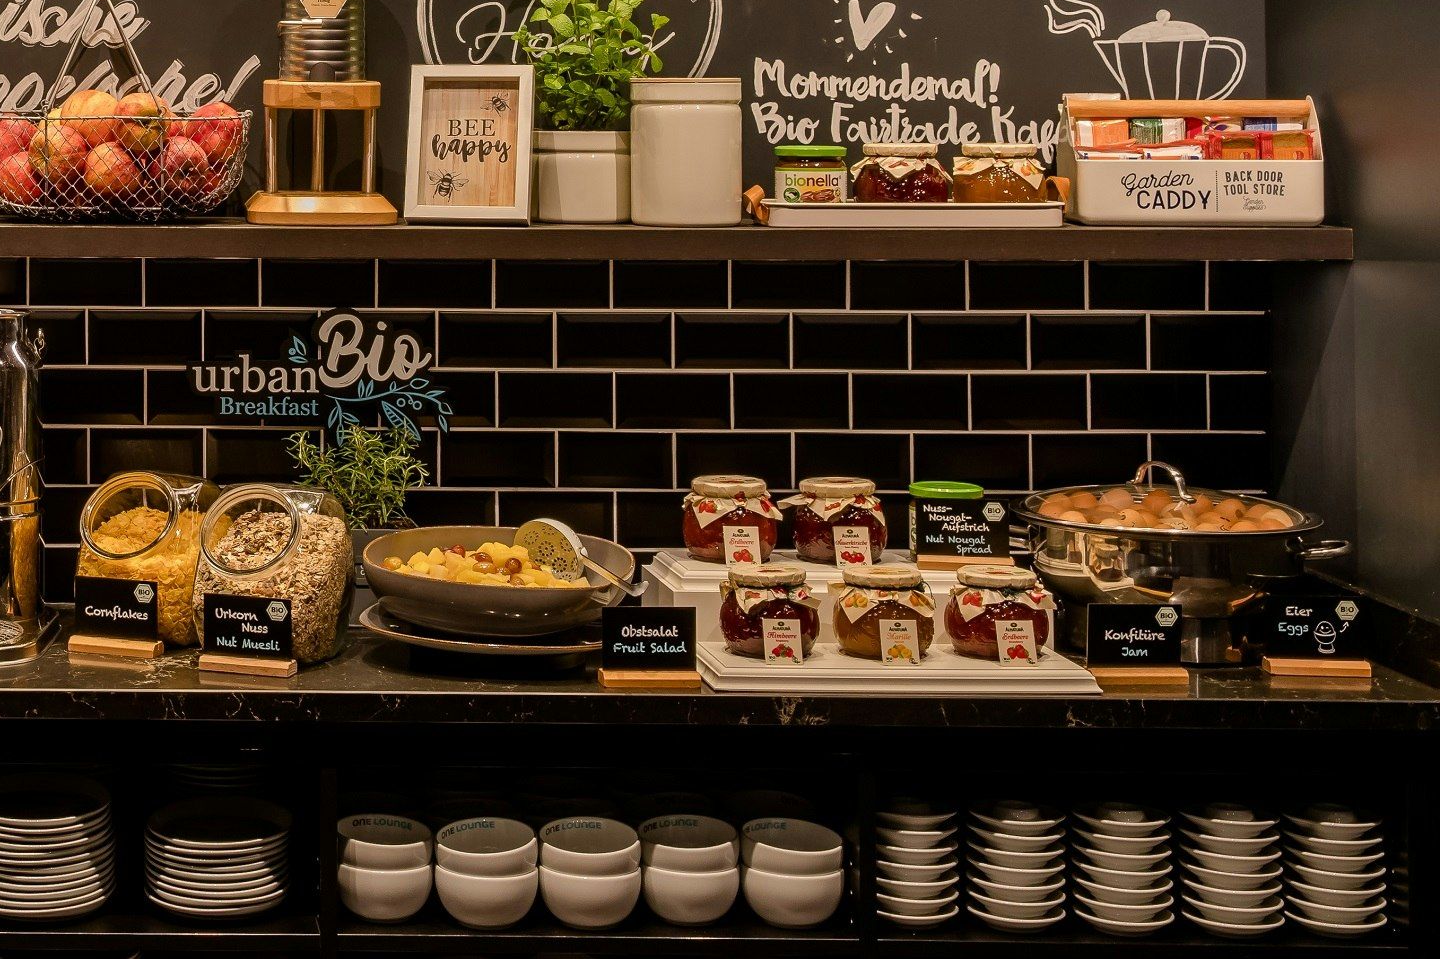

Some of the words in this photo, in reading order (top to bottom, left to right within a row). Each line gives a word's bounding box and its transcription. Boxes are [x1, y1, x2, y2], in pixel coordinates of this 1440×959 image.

[447, 118, 496, 137] BEE
[750, 101, 821, 145] Bio
[830, 101, 982, 145] Fairtrade
[431, 133, 512, 164] happy
[785, 173, 839, 187] bionella
[1121, 169, 1195, 197] Garden
[1224, 170, 1253, 183] BACK
[1257, 170, 1284, 183] DOOR
[1223, 183, 1249, 196] TOOL
[1253, 183, 1286, 197] STORE
[1136, 190, 1212, 210] CADDY
[192, 353, 320, 394] urban
[318, 312, 432, 389] Bio
[219, 396, 320, 417] Breakfast
[922, 503, 953, 513] Nuss-
[928, 512, 972, 525] Nougat-
[941, 522, 990, 533] Aufstrich
[925, 534, 945, 544] Nut
[948, 535, 986, 547] Nougat
[956, 544, 993, 557] Spread
[84, 605, 149, 621] Cornflakes
[214, 607, 259, 622] Urkorn
[1285, 606, 1314, 617] Eier
[241, 622, 269, 634] Nuss
[620, 623, 679, 639] Obstsalat
[1104, 627, 1166, 642] Konfitüre
[1277, 622, 1310, 636] Eggs
[216, 636, 238, 648] Nut
[241, 638, 281, 651] Muesli
[612, 641, 646, 654] Fruit
[649, 641, 688, 654] Salad
[1121, 646, 1149, 657] Jam
